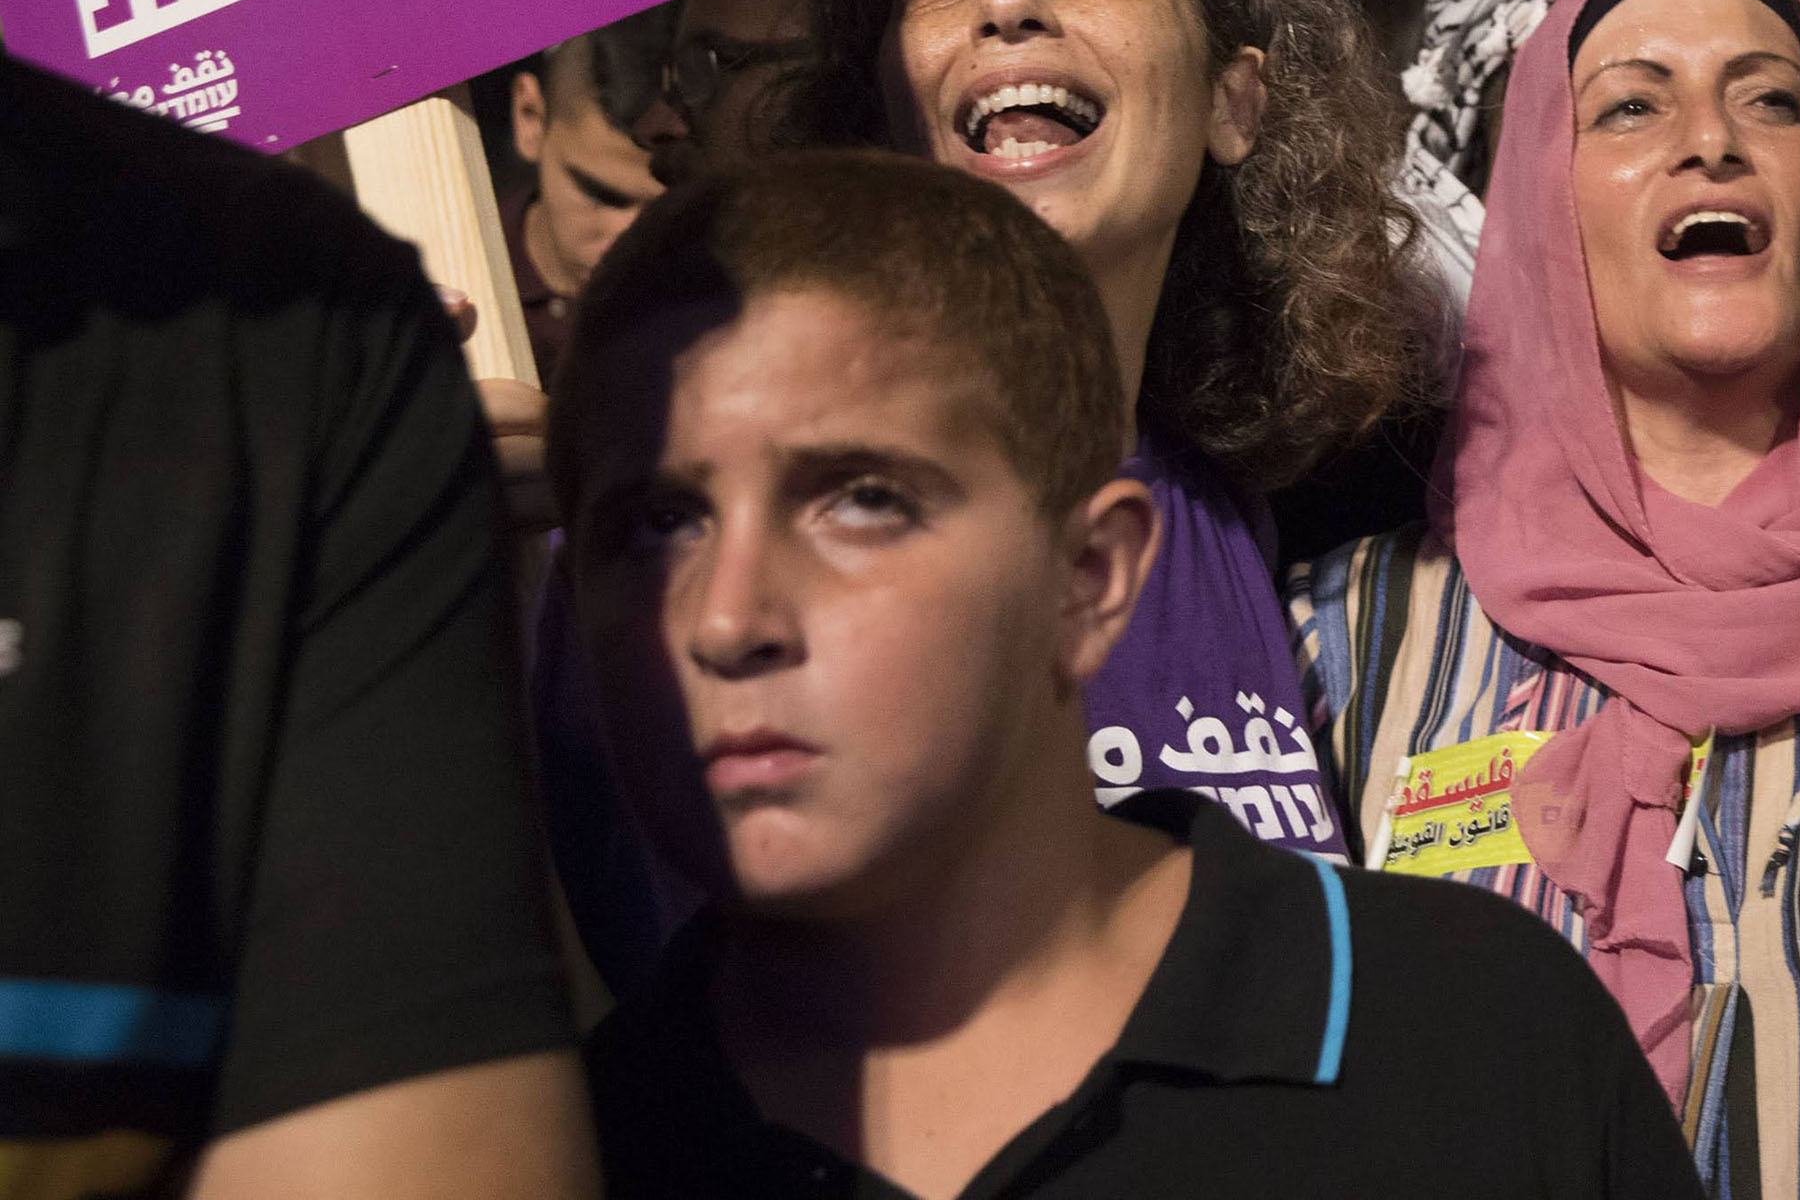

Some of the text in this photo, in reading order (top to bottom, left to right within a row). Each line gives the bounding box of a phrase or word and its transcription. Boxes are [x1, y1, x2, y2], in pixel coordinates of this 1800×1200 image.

[162, 50, 235, 94] نقف
[1158, 690, 1320, 774] نقف
[1449, 803, 1511, 848] قانون
